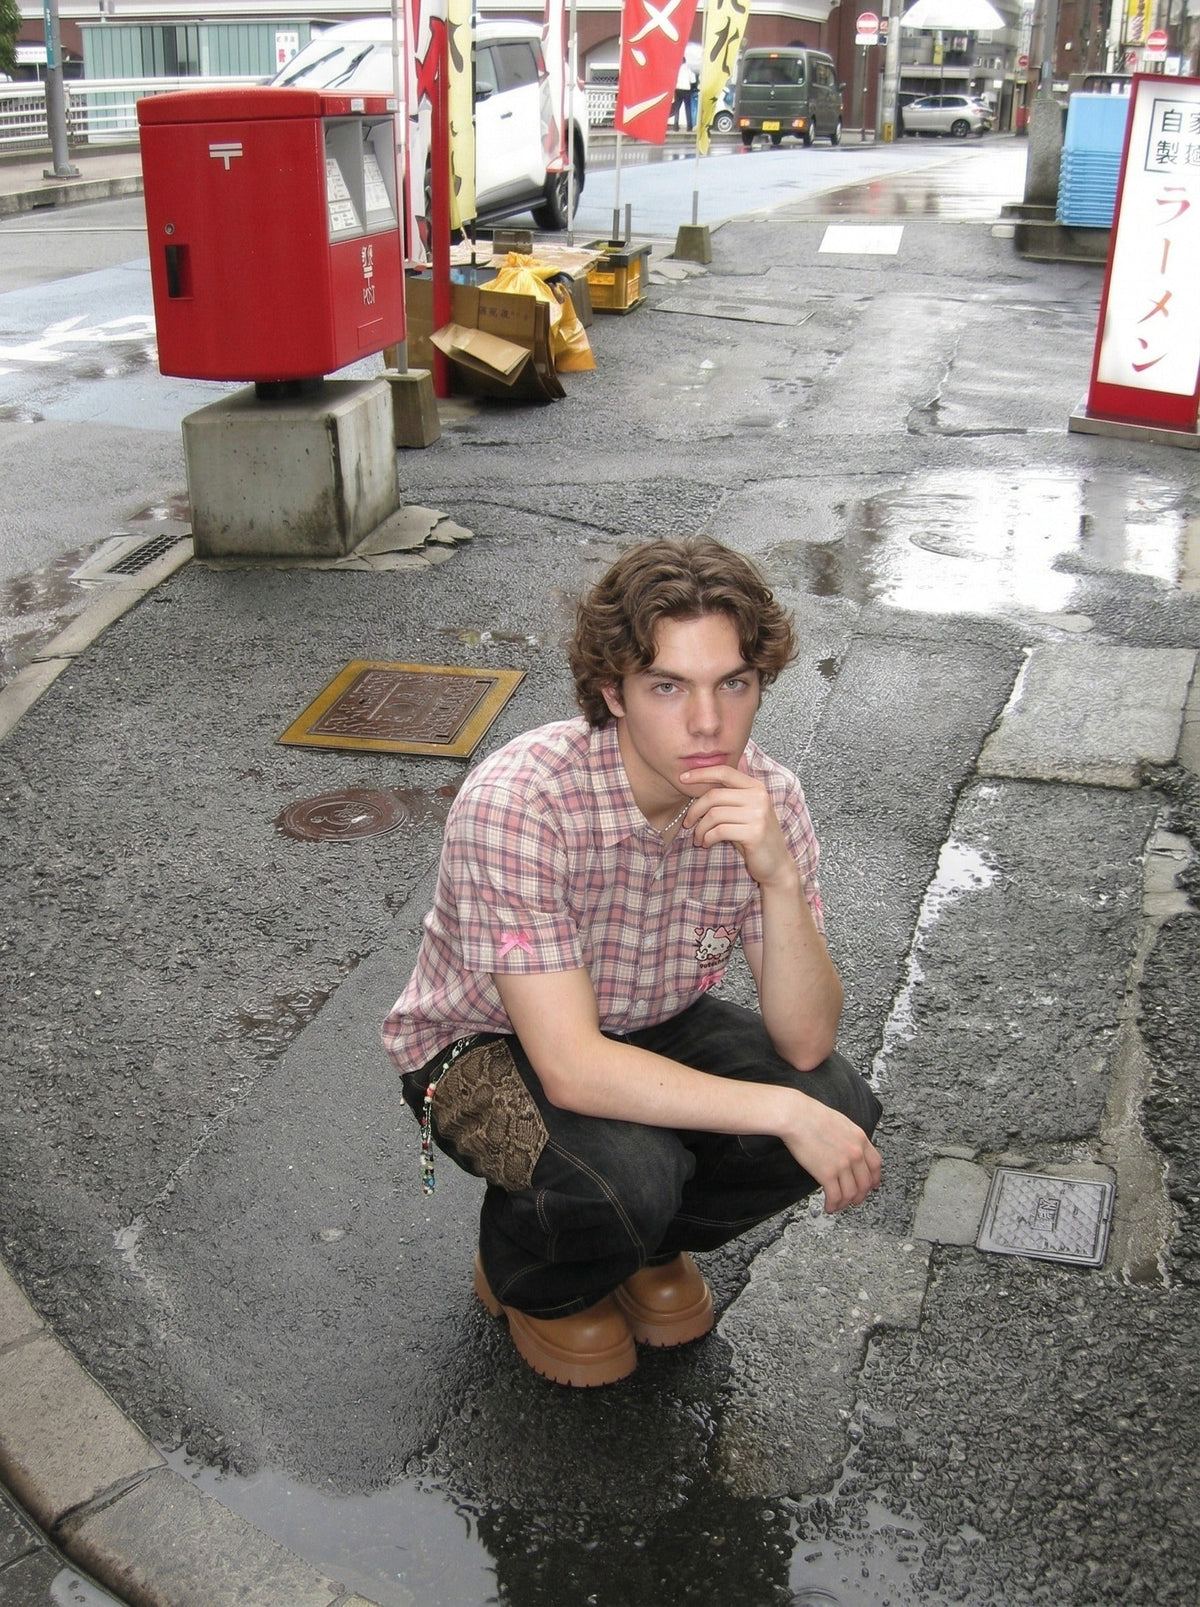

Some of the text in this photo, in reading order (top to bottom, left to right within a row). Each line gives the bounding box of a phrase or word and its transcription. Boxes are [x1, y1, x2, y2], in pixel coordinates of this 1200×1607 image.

[362, 284, 376, 305] POST
[1132, 186, 1191, 373] ラーメン
